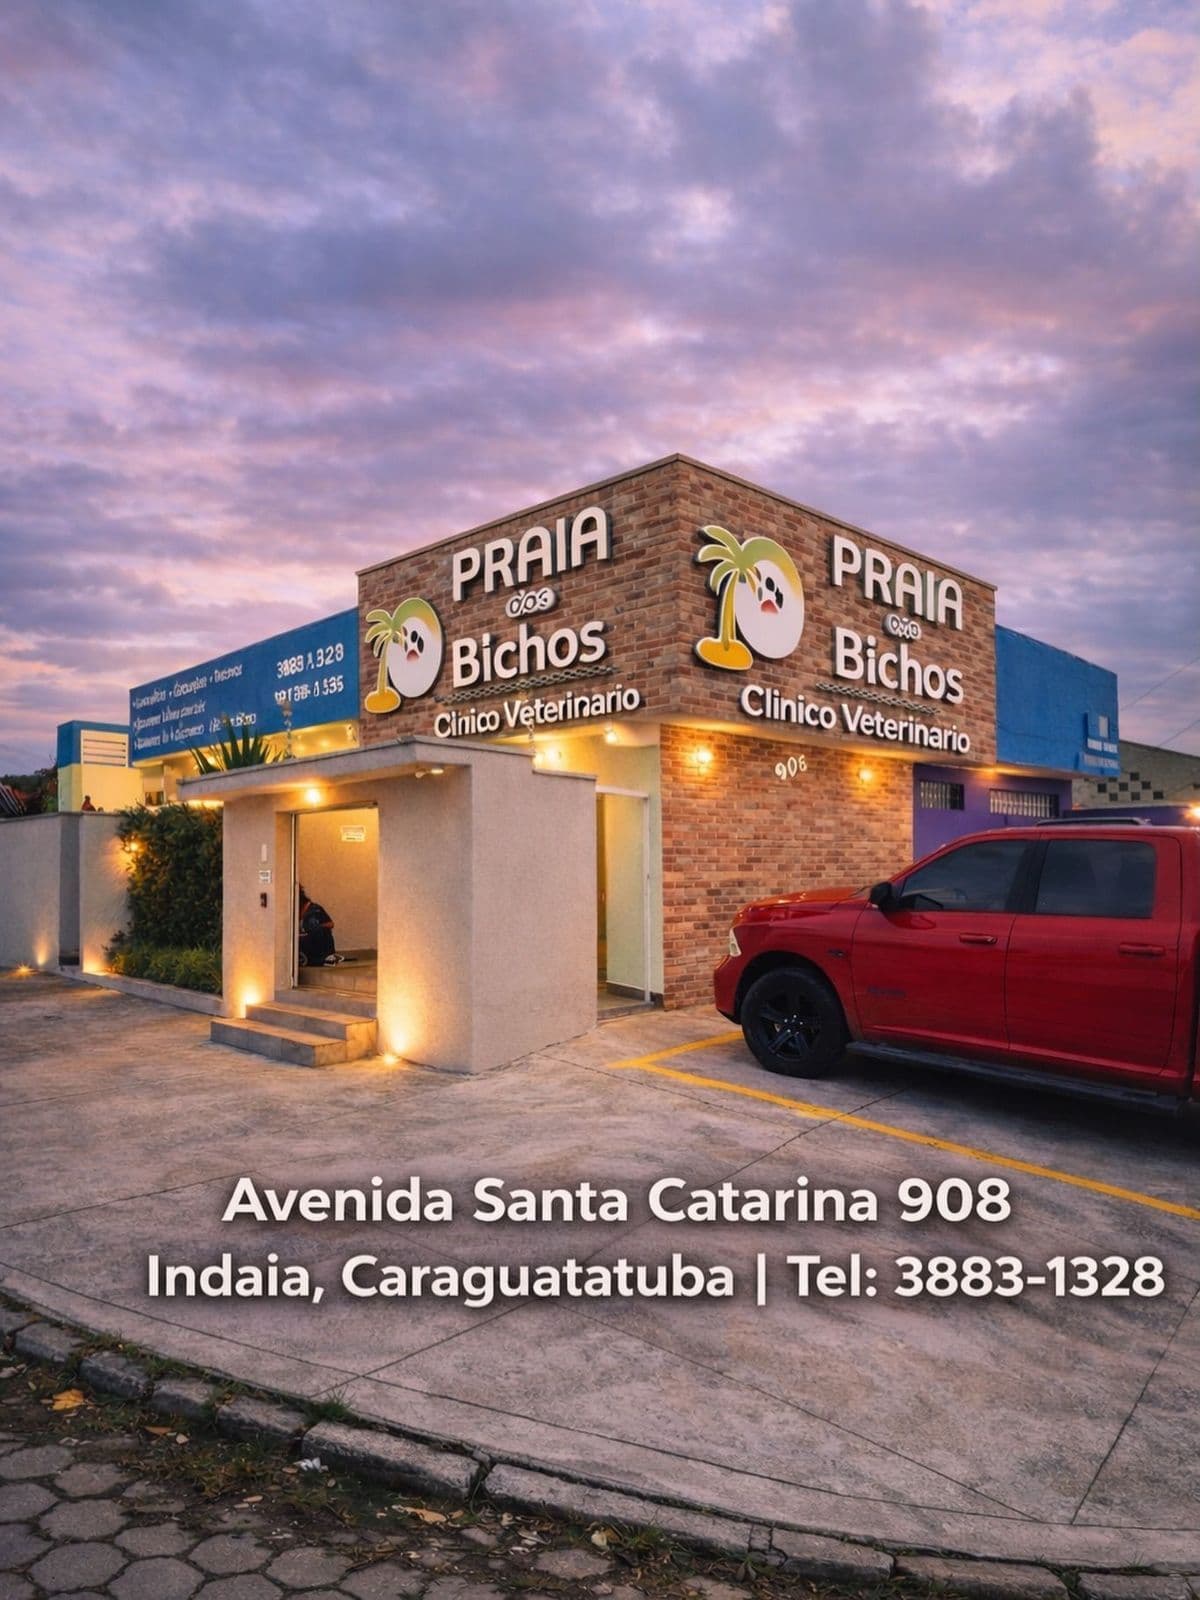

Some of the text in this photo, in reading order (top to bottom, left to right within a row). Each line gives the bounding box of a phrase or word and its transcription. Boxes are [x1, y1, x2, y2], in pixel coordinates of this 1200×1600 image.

[452, 506, 608, 602] PRAIA
[833, 534, 963, 631] PRAIA
[452, 620, 606, 689] Bichos
[835, 626, 964, 704] Bichos
[503, 684, 640, 728] Veterinario
[741, 684, 971, 753] Clinico Veterinario
